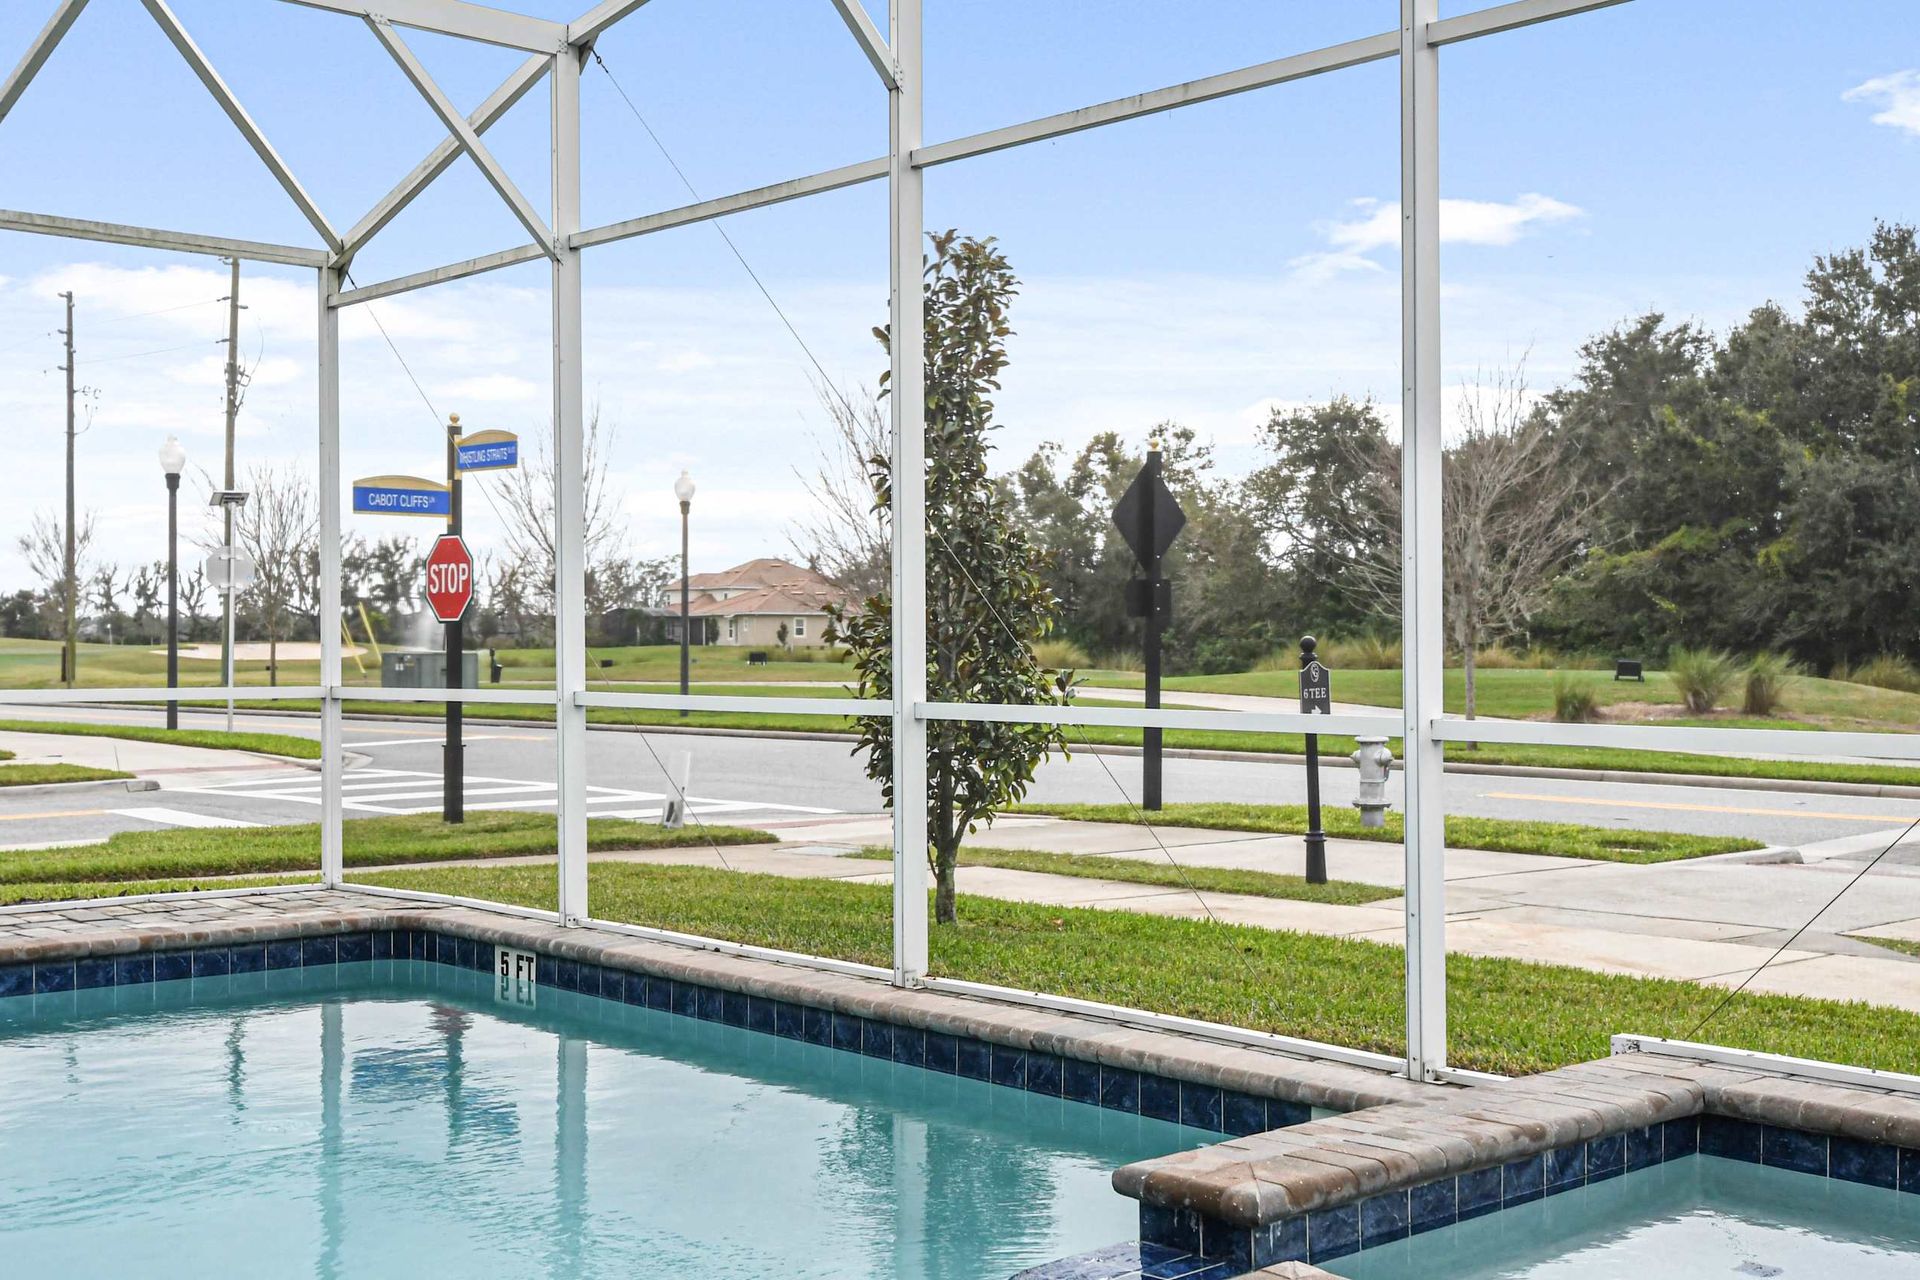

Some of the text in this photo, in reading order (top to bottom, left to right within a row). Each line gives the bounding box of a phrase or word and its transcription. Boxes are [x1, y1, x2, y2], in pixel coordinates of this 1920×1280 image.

[487, 447, 508, 462] STRAITS
[368, 493, 398, 507] CABOT
[400, 495, 429, 508] CLIFFS
[429, 563, 469, 594] STOP
[1303, 687, 1327, 699] 6 TEE
[501, 951, 509, 976] 5
